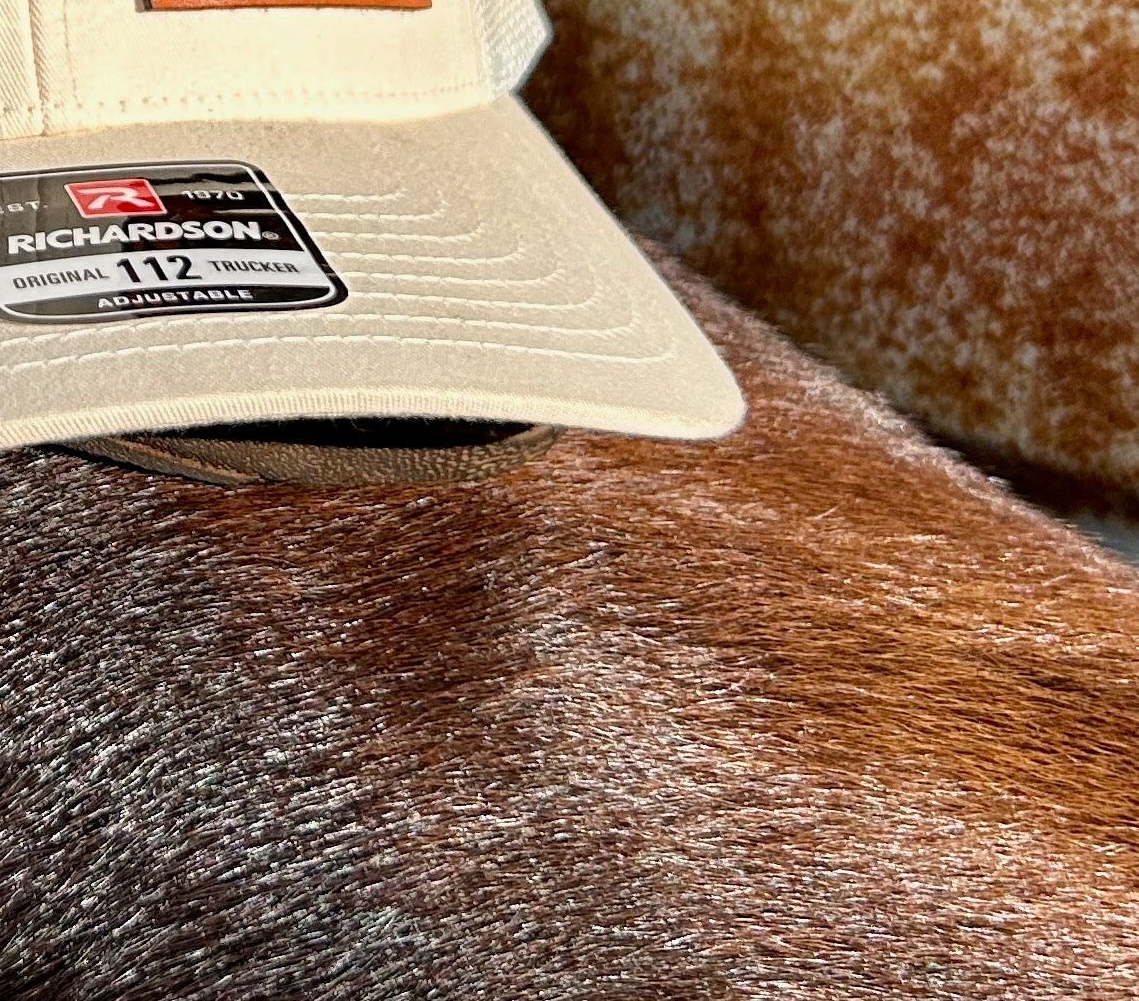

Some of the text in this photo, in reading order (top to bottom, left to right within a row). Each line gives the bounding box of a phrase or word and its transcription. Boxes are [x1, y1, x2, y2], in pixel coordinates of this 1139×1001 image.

[180, 189, 246, 201] 1970
[12, 254, 300, 290] ORIGINAL 112 TRUCKER
[97, 289, 254, 309] ADJUSTABLE
